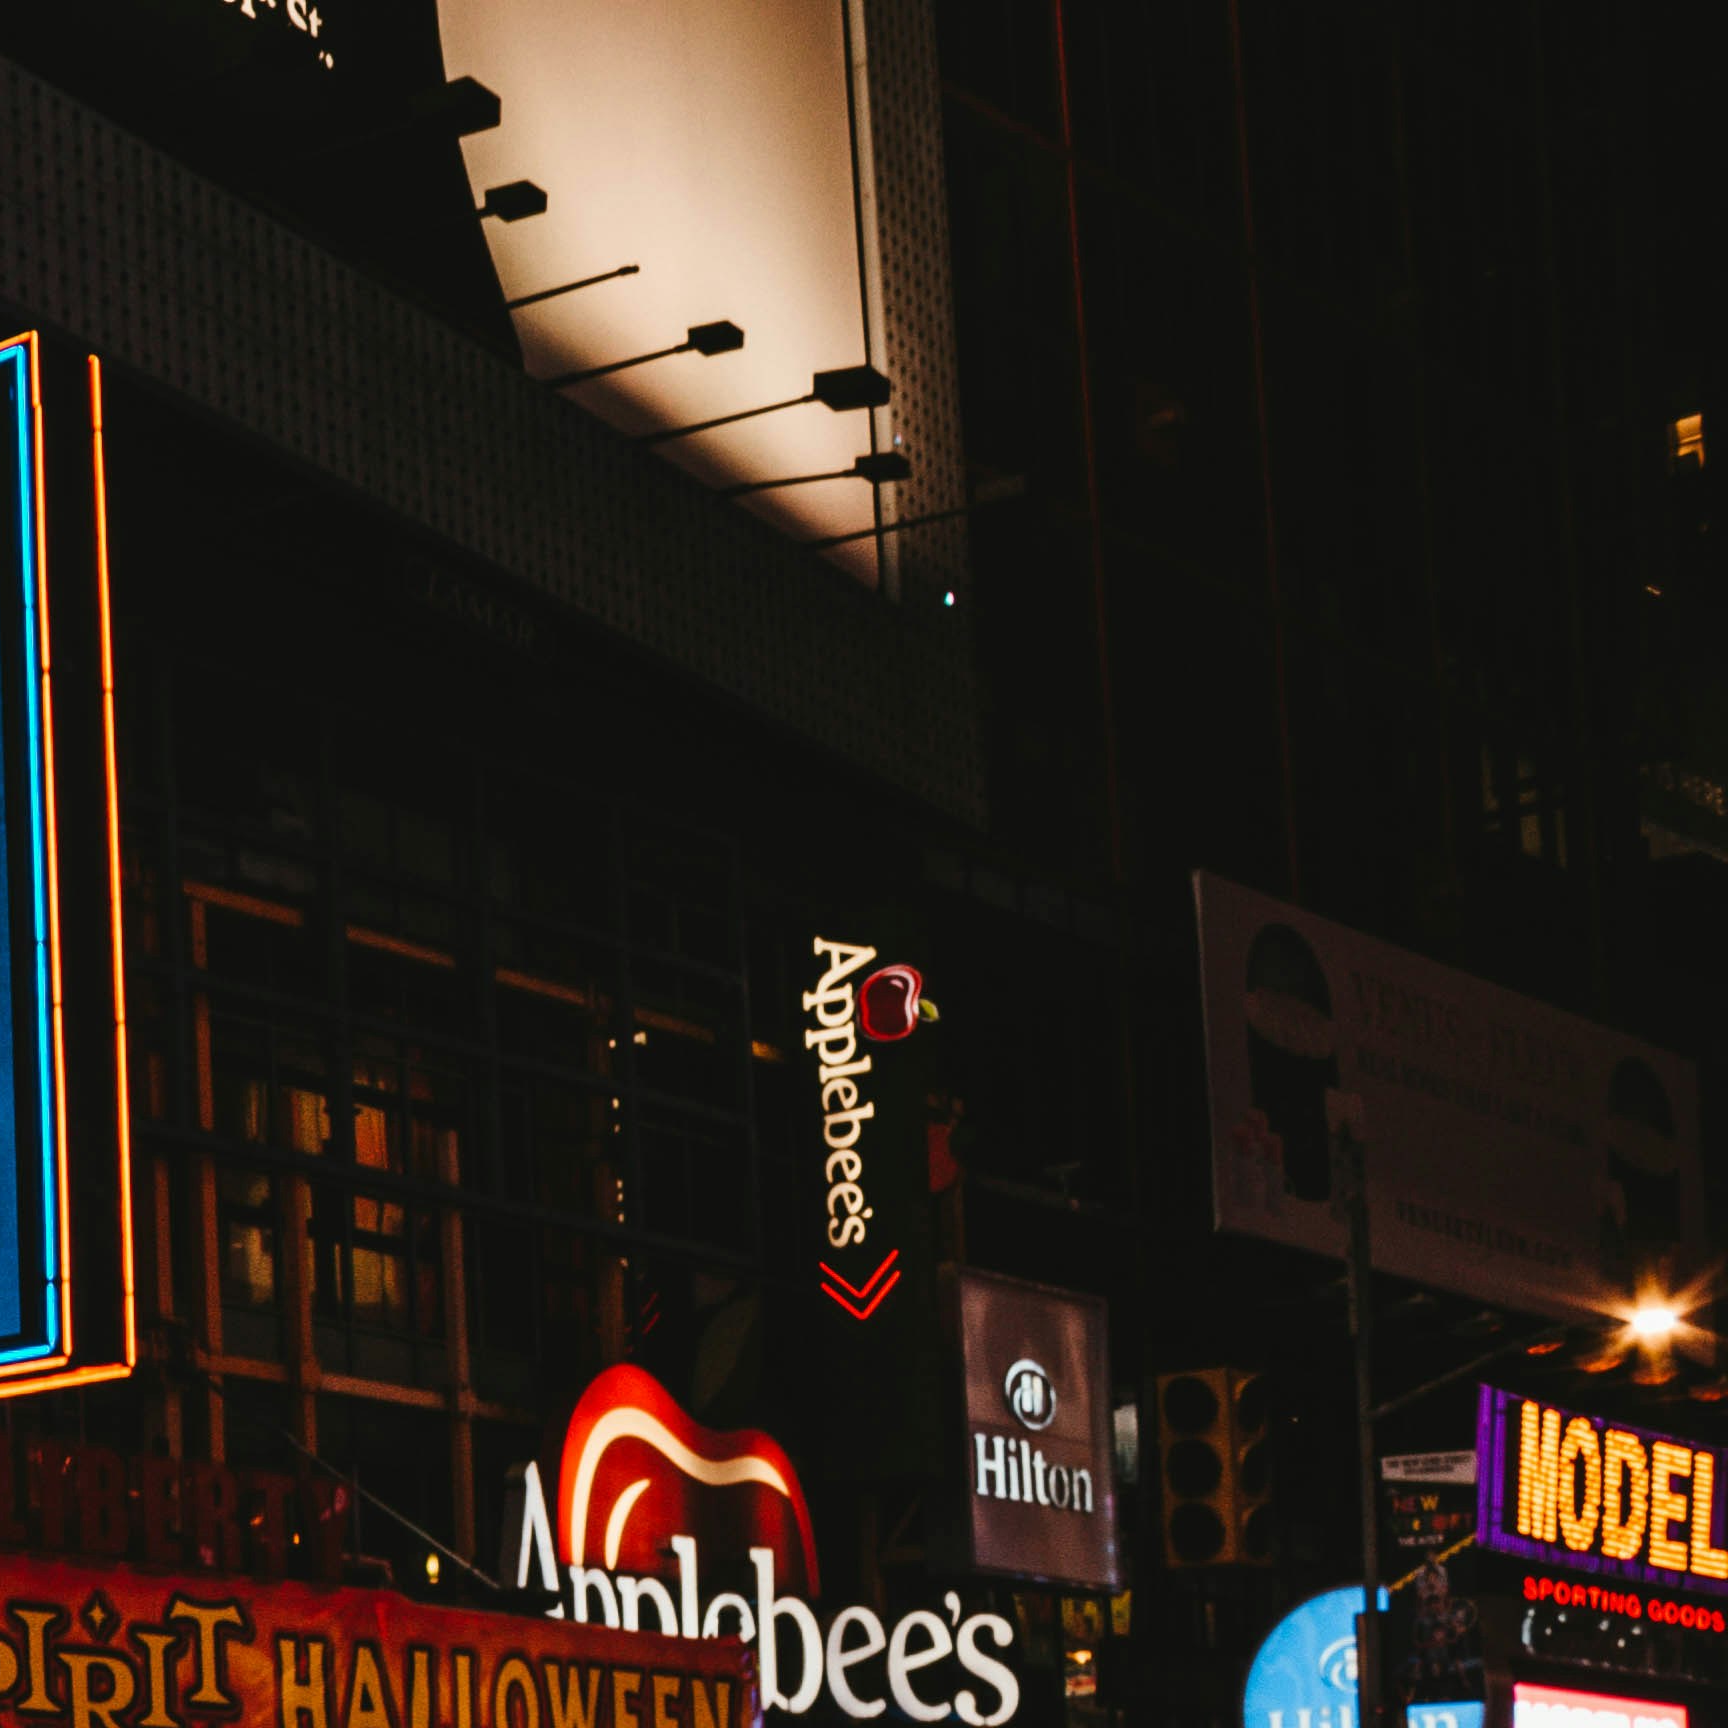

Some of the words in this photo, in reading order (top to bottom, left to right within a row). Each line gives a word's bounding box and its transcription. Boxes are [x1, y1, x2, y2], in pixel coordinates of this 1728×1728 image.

[804, 936, 876, 1250] Applebee's
[974, 1432, 1093, 1514] Hilton
[1516, 1400, 1728, 1580] MODEL
[518, 1461, 1020, 1727] Applebee's
[1523, 1576, 1642, 1618] SPORTING
[1647, 1600, 1726, 1632] GOODS
